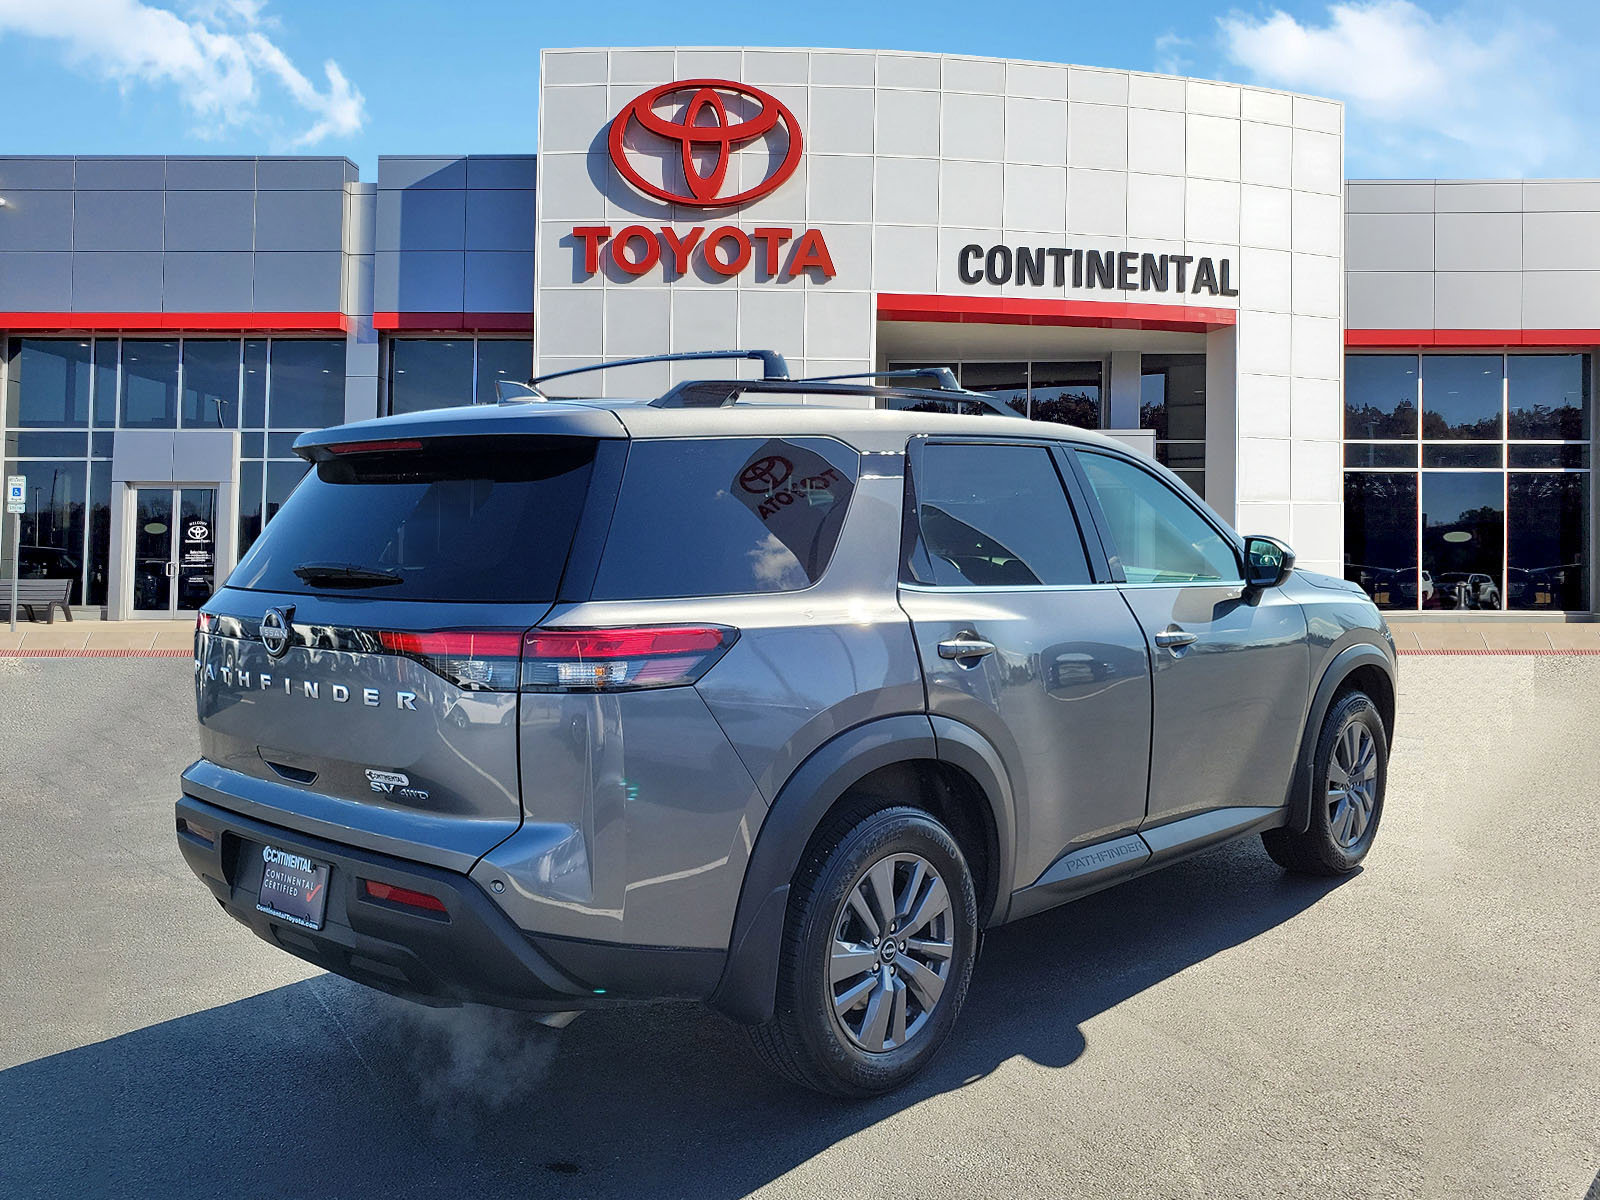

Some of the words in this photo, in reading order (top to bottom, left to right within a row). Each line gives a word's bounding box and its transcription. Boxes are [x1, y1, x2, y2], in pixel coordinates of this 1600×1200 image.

[573, 225, 837, 277] TOYOTA
[959, 244, 1239, 297] CONTINENTAL
[195, 659, 417, 711] PATHFINDER
[370, 781, 394, 793] SV
[400, 788, 429, 799] 4WD
[1065, 840, 1145, 872] PATHFINDER
[264, 879, 298, 897] CERTIFIED
[266, 868, 314, 891] CONTINENTAL
